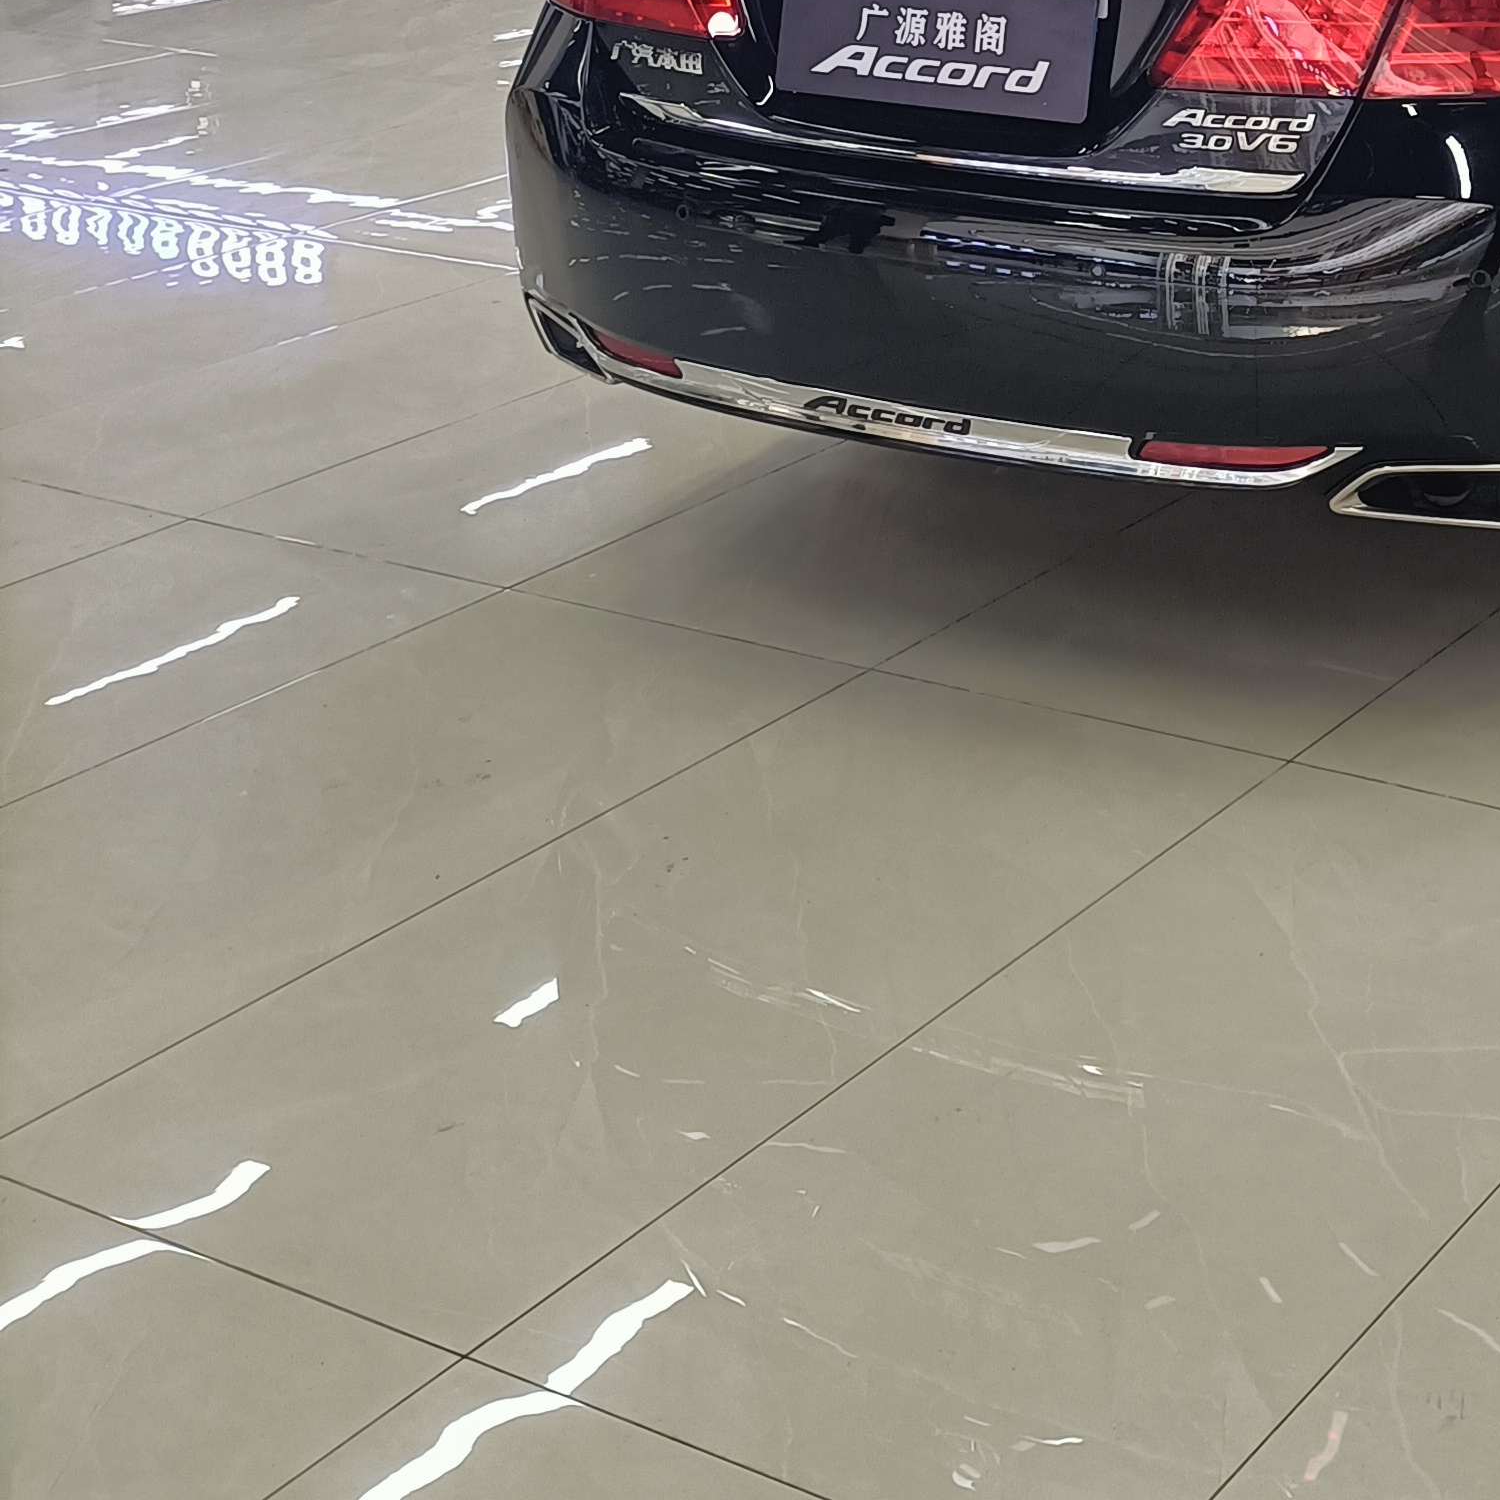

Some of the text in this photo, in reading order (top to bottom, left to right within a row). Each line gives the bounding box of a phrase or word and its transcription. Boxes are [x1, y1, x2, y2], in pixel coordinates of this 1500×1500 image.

[856, 3, 1008, 55] 广源雅阁
[610, 39, 703, 75] 广汽本田
[811, 44, 1050, 94] Accord
[1162, 108, 1316, 133] Accord
[803, 395, 971, 435] Accord
